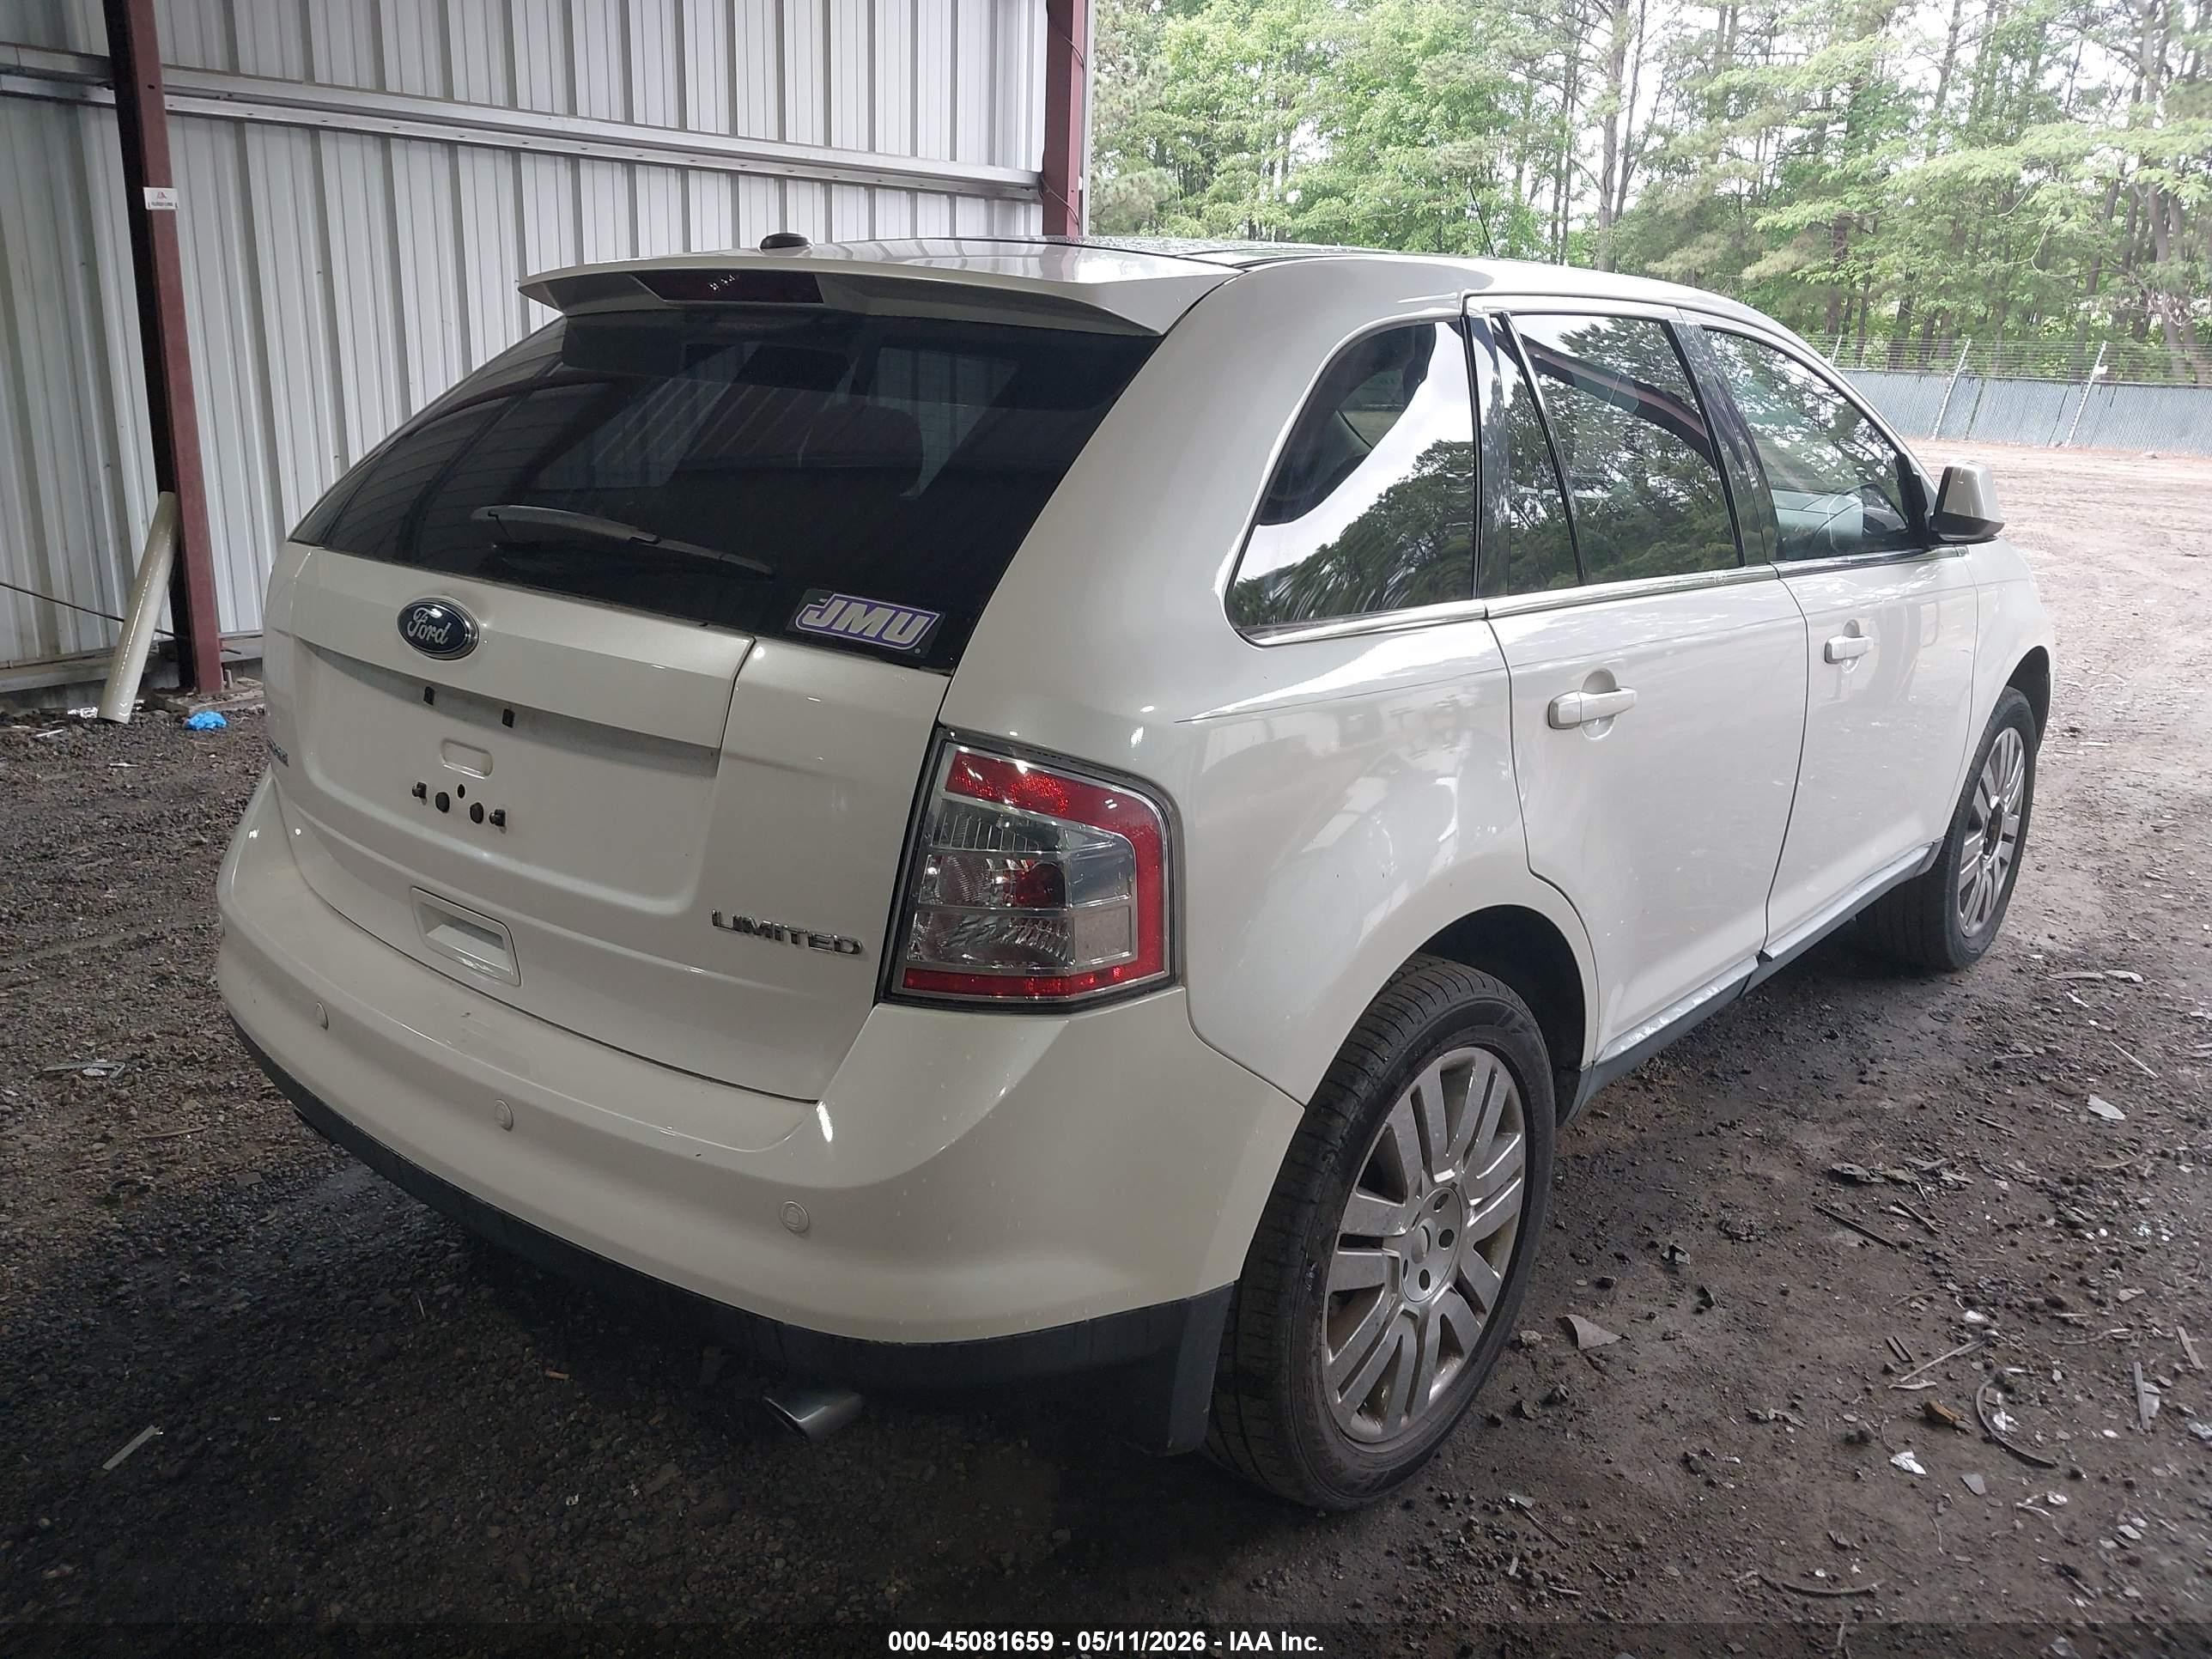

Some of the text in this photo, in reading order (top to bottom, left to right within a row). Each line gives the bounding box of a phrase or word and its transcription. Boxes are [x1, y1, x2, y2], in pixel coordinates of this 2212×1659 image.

[407, 606, 452, 645] Ford
[799, 598, 933, 646] JMU
[711, 908, 863, 956] LIMITED
